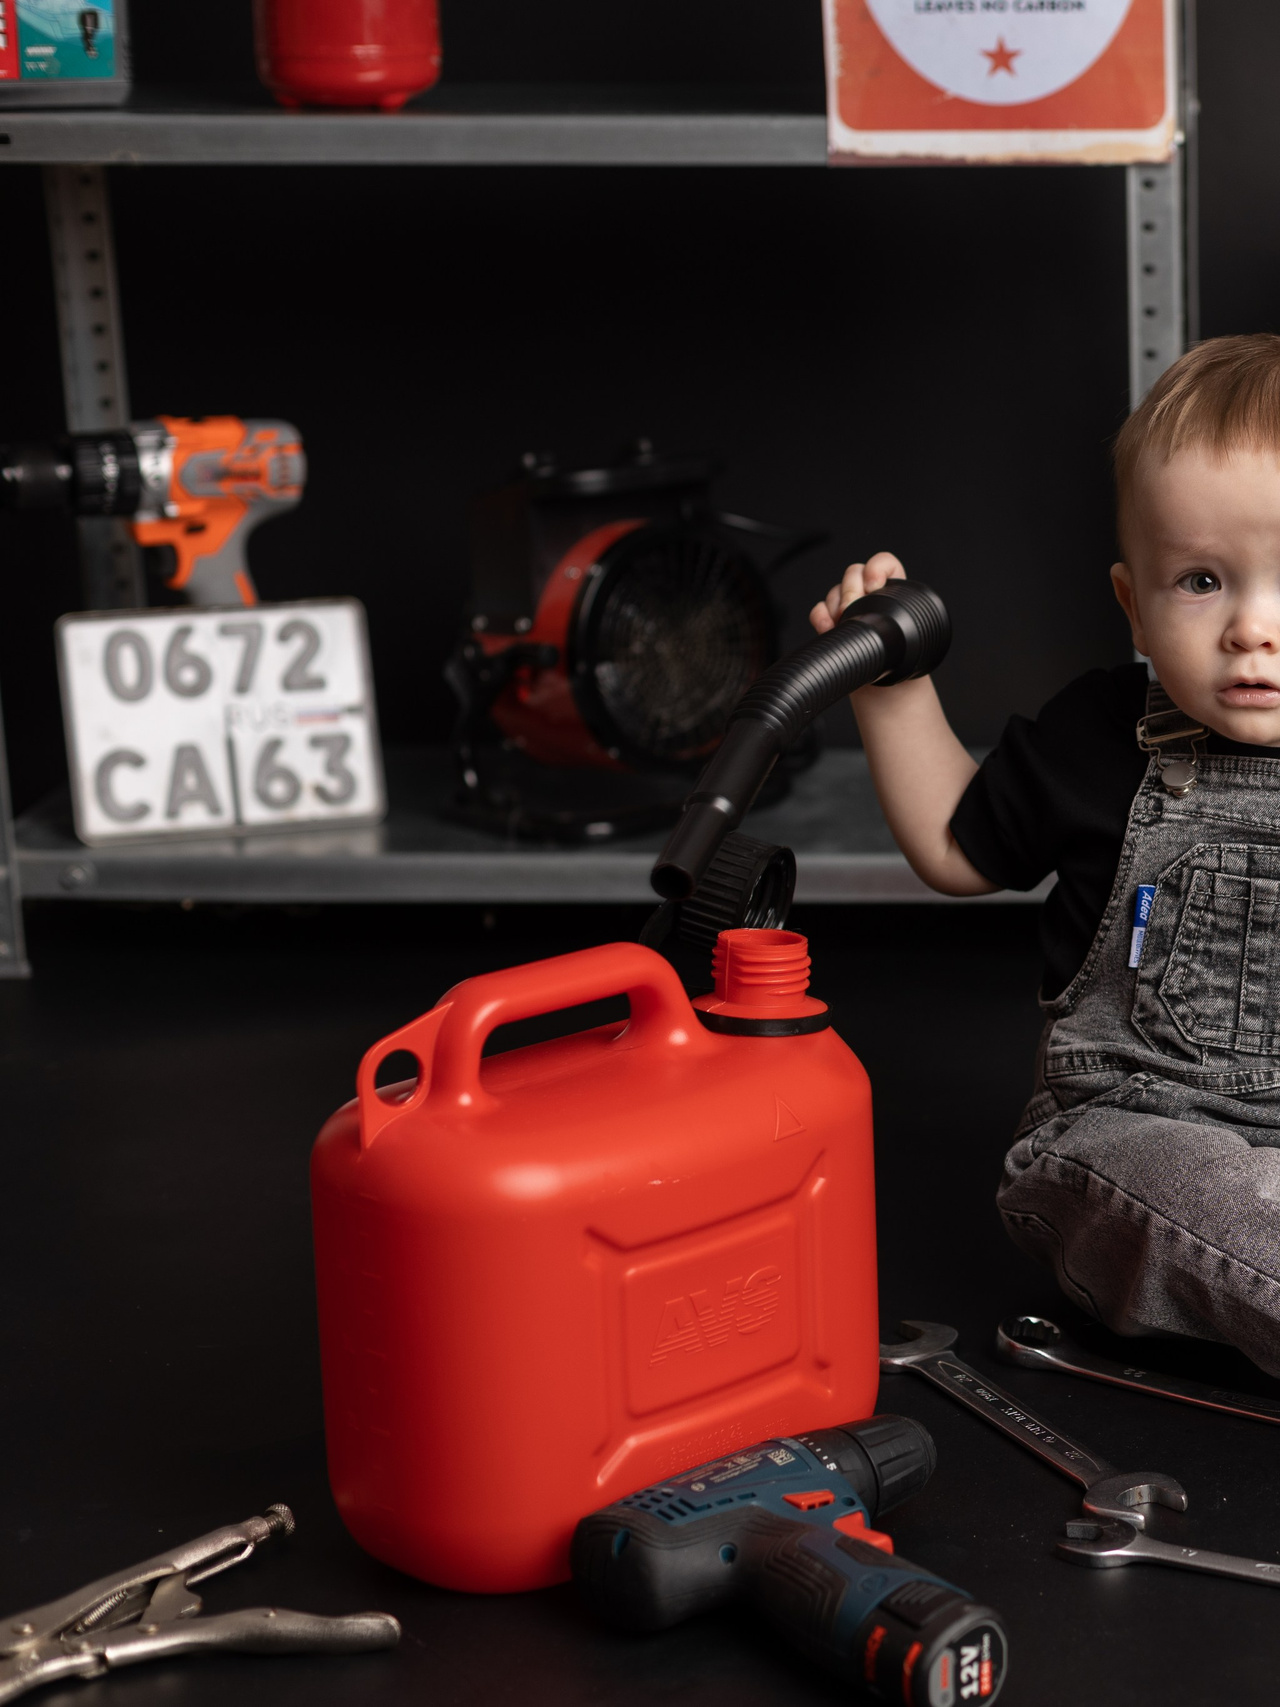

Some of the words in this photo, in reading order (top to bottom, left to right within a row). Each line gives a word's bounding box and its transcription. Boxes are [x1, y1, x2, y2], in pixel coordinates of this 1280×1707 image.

[914, 0, 976, 14] LEAVES
[980, 0, 1009, 14] NO
[1013, 0, 1086, 14] CARBON
[94, 743, 222, 824] CA
[253, 733, 357, 812] 63
[648, 1264, 782, 1370] AVS
[959, 1644, 981, 1701] 12V
